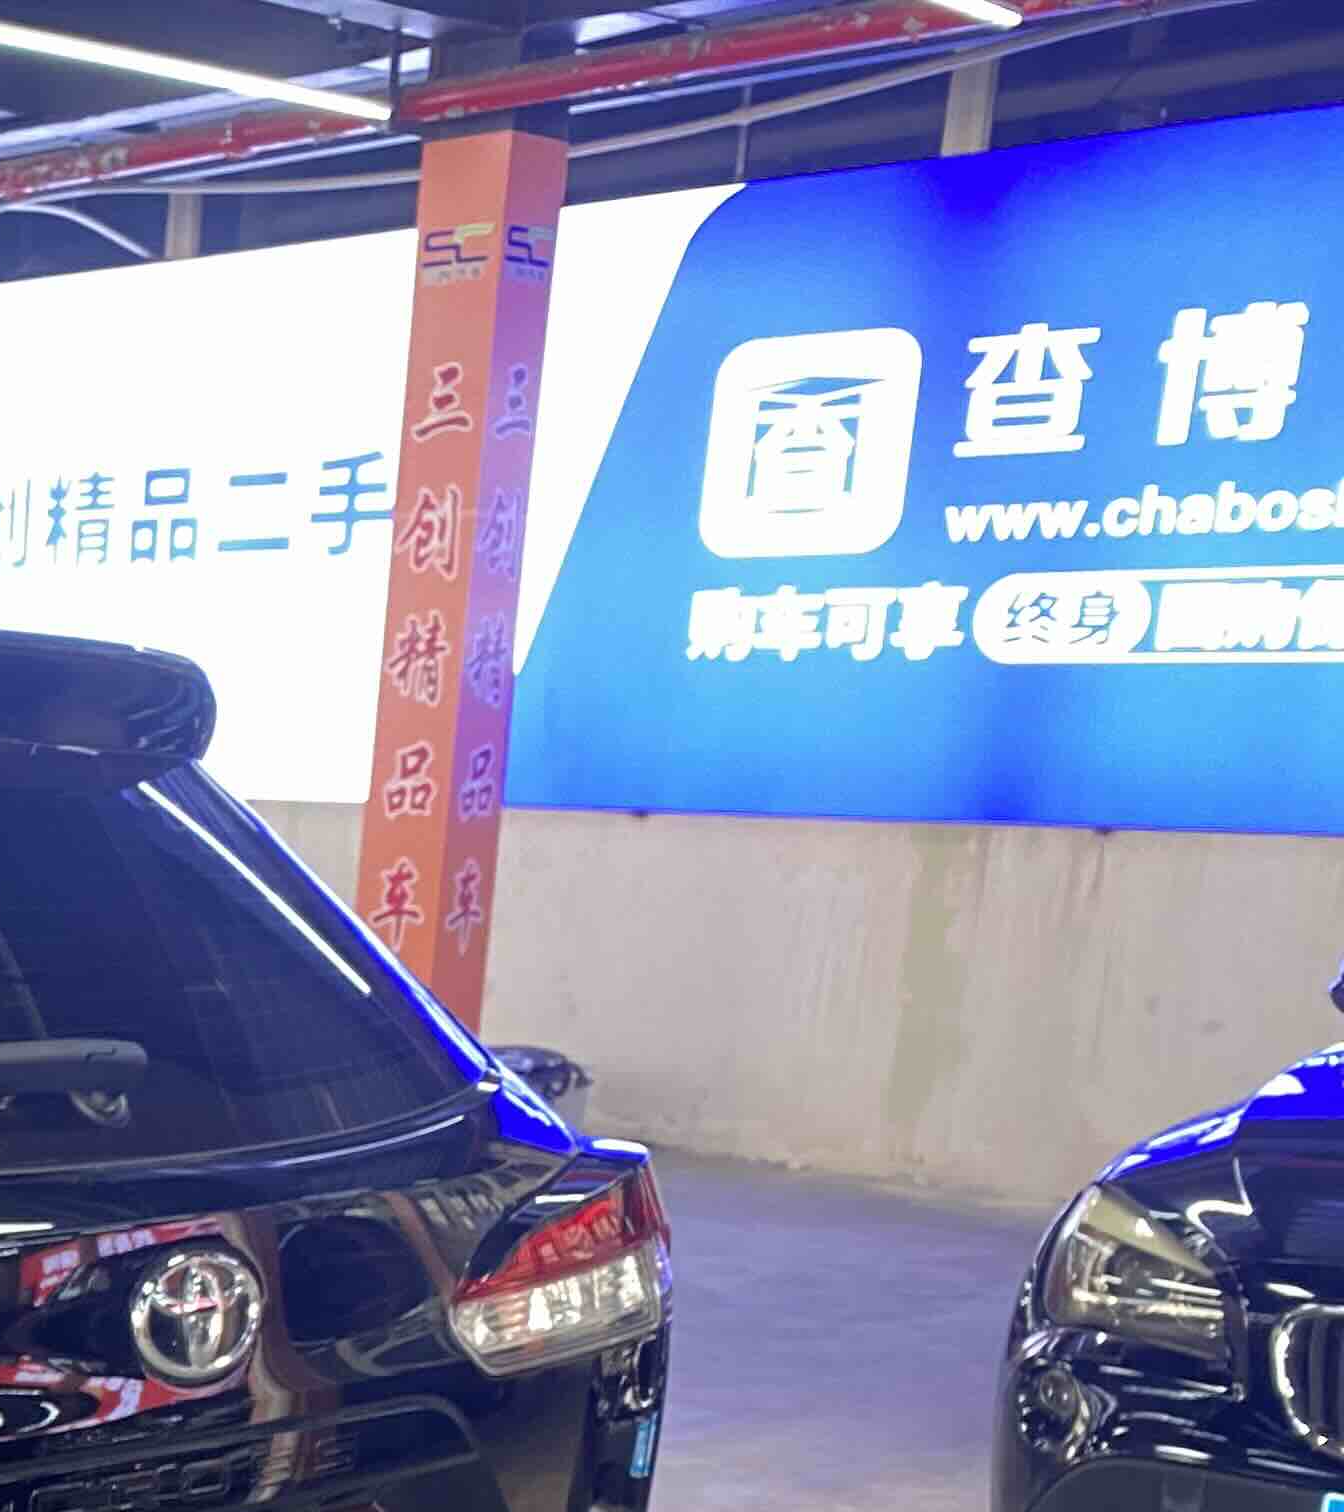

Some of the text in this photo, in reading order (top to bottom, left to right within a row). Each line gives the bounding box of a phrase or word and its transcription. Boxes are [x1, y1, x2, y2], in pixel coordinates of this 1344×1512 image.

[953, 300, 1310, 458] 查博
[370, 362, 472, 953] 三创精品车
[685, 580, 969, 663] 购车可享
[1002, 590, 1119, 646] 终身
